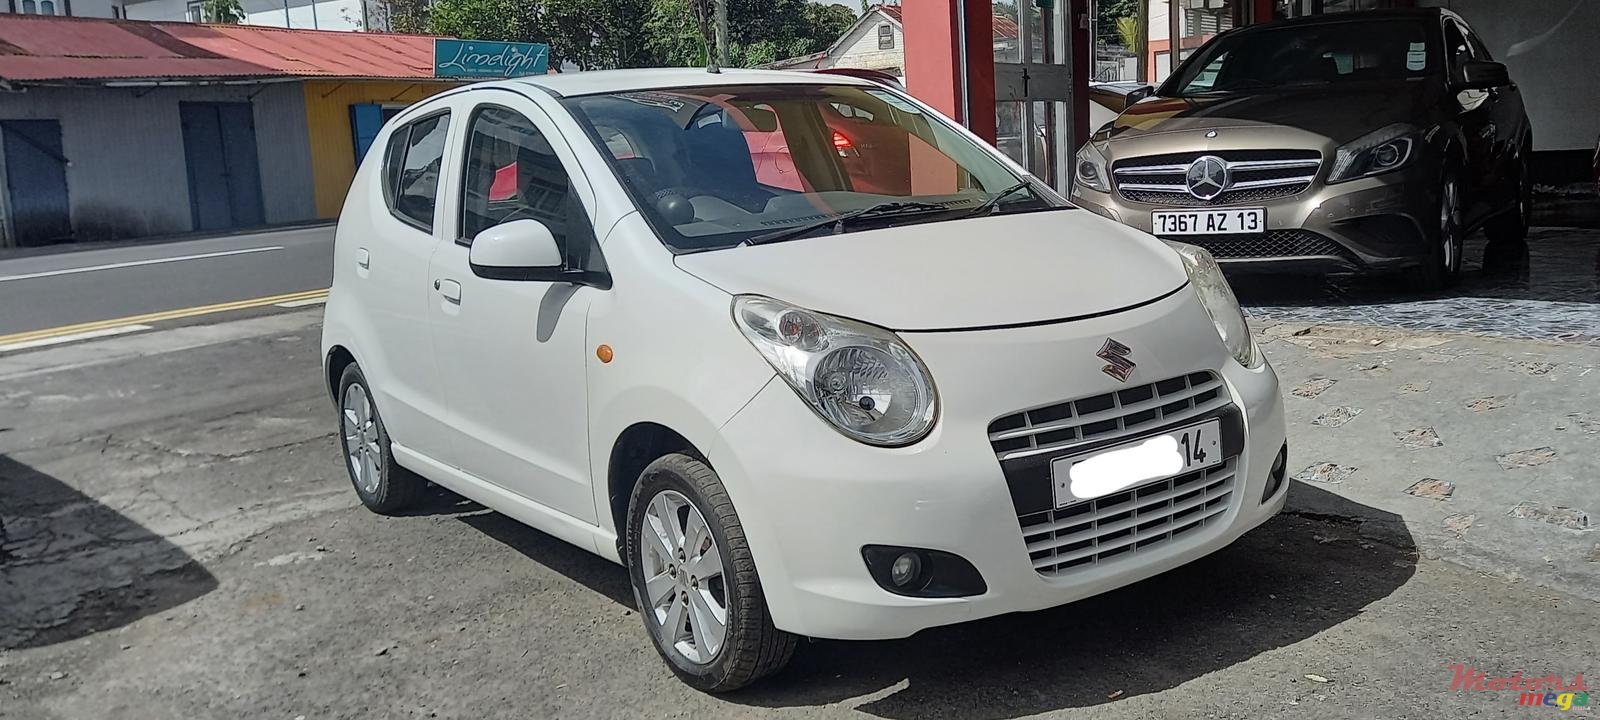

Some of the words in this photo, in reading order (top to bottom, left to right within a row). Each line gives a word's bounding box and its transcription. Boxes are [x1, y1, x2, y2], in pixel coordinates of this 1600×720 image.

[439, 42, 546, 77] Limelight
[1158, 214, 1198, 232] 7367
[1206, 213, 1227, 231] AZ
[1237, 212, 1258, 231] 13
[1181, 429, 1206, 467] 14
